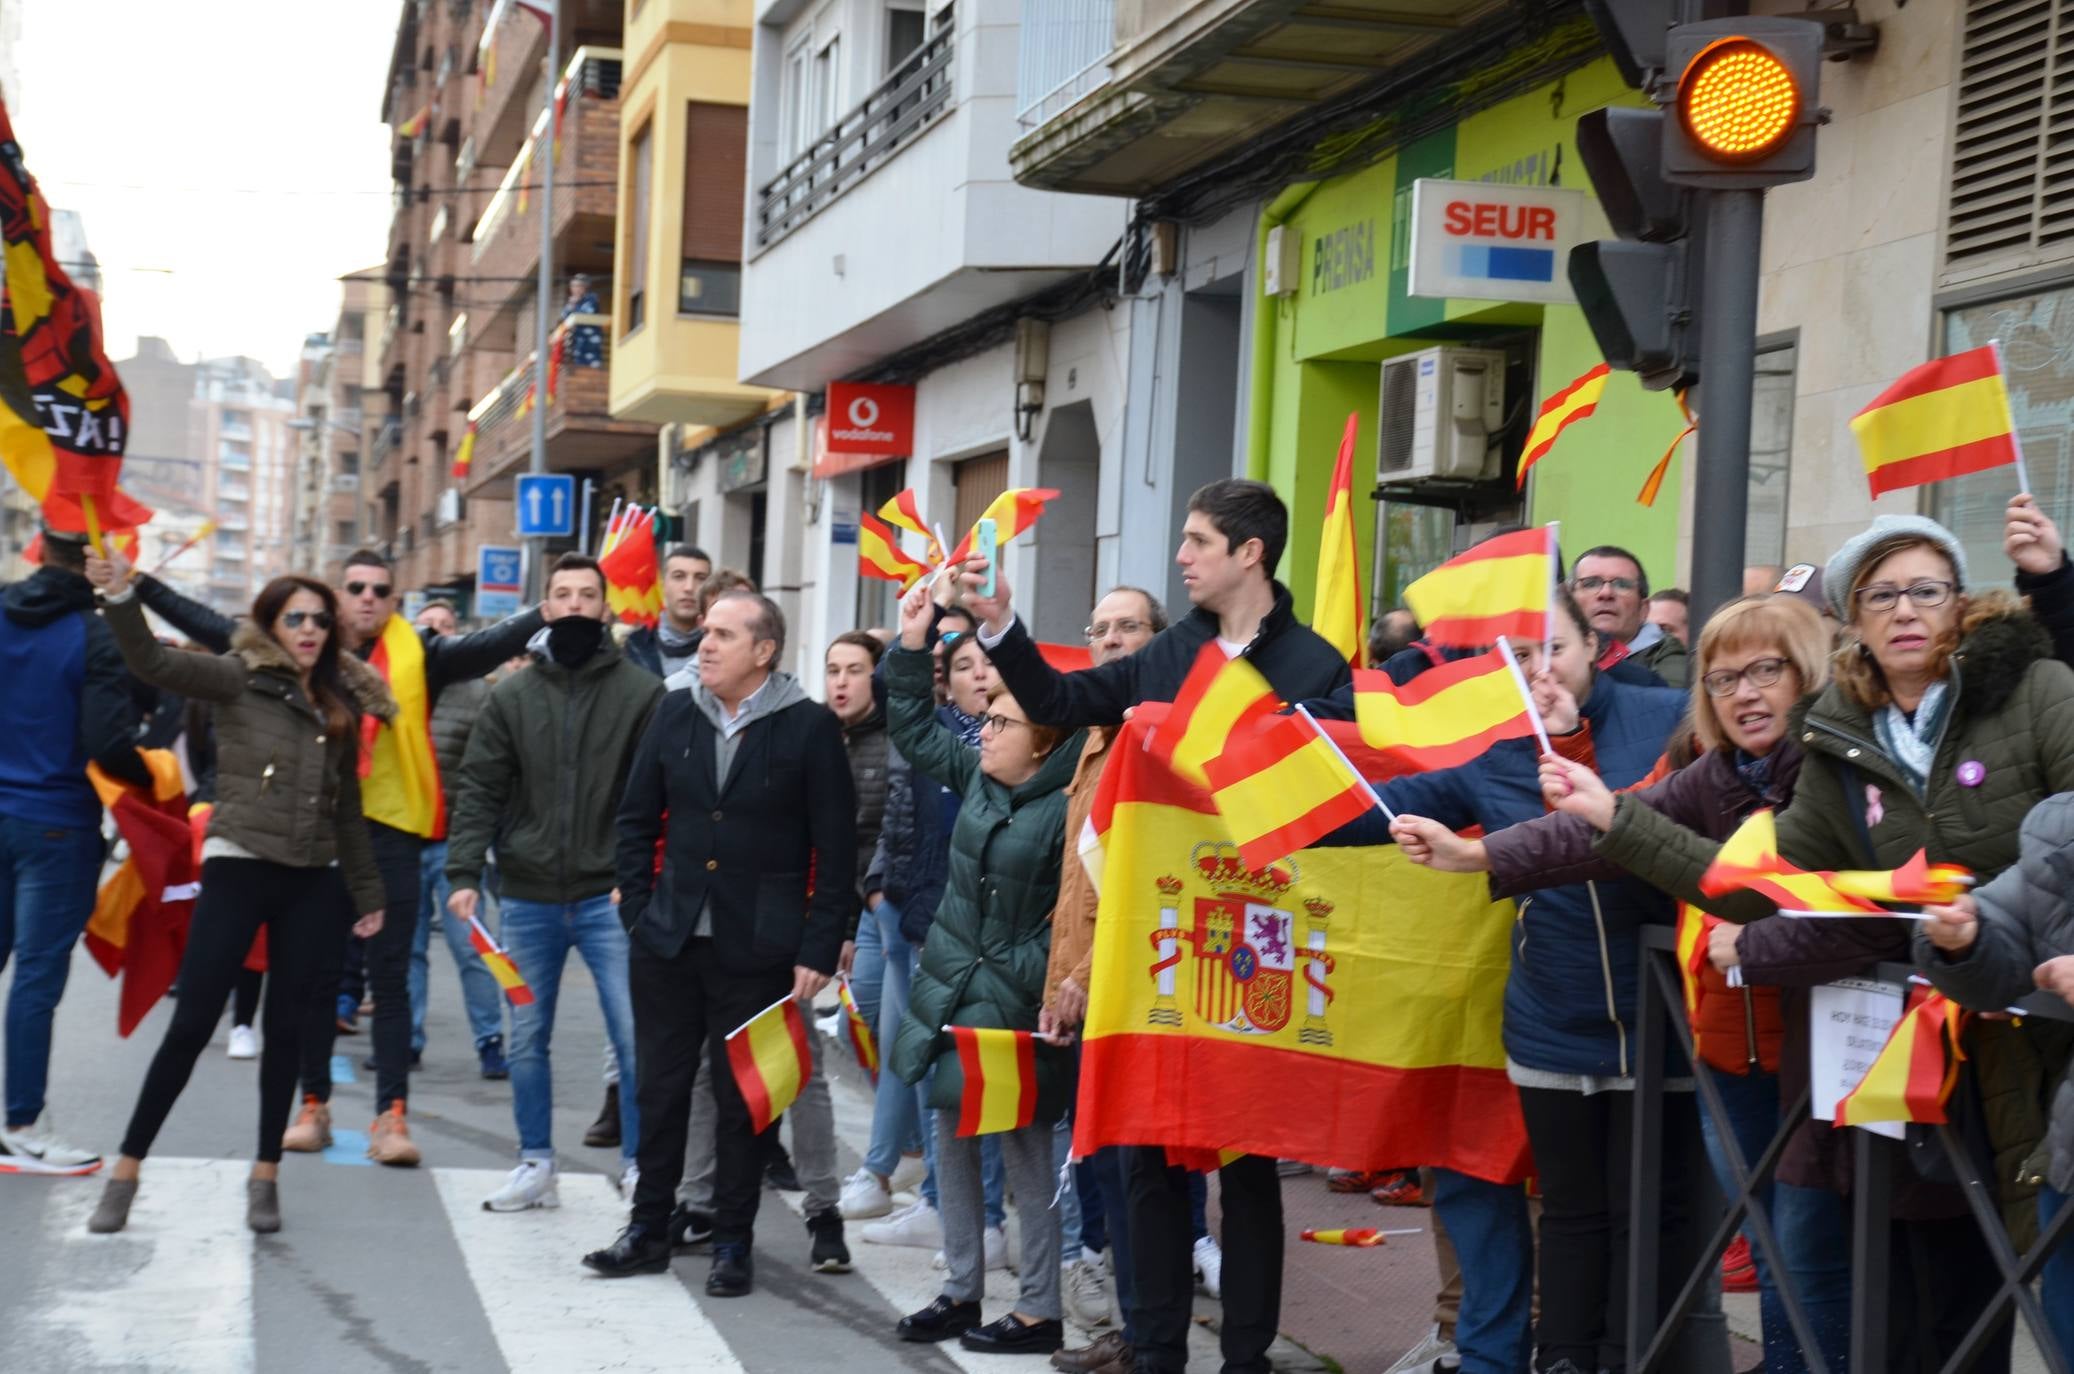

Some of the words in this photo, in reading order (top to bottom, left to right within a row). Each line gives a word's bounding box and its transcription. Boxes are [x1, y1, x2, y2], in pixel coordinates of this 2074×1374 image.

[1444, 201, 1556, 242] SEUR
[1312, 217, 1375, 298] PRENSA
[832, 427, 895, 443] vodafone
